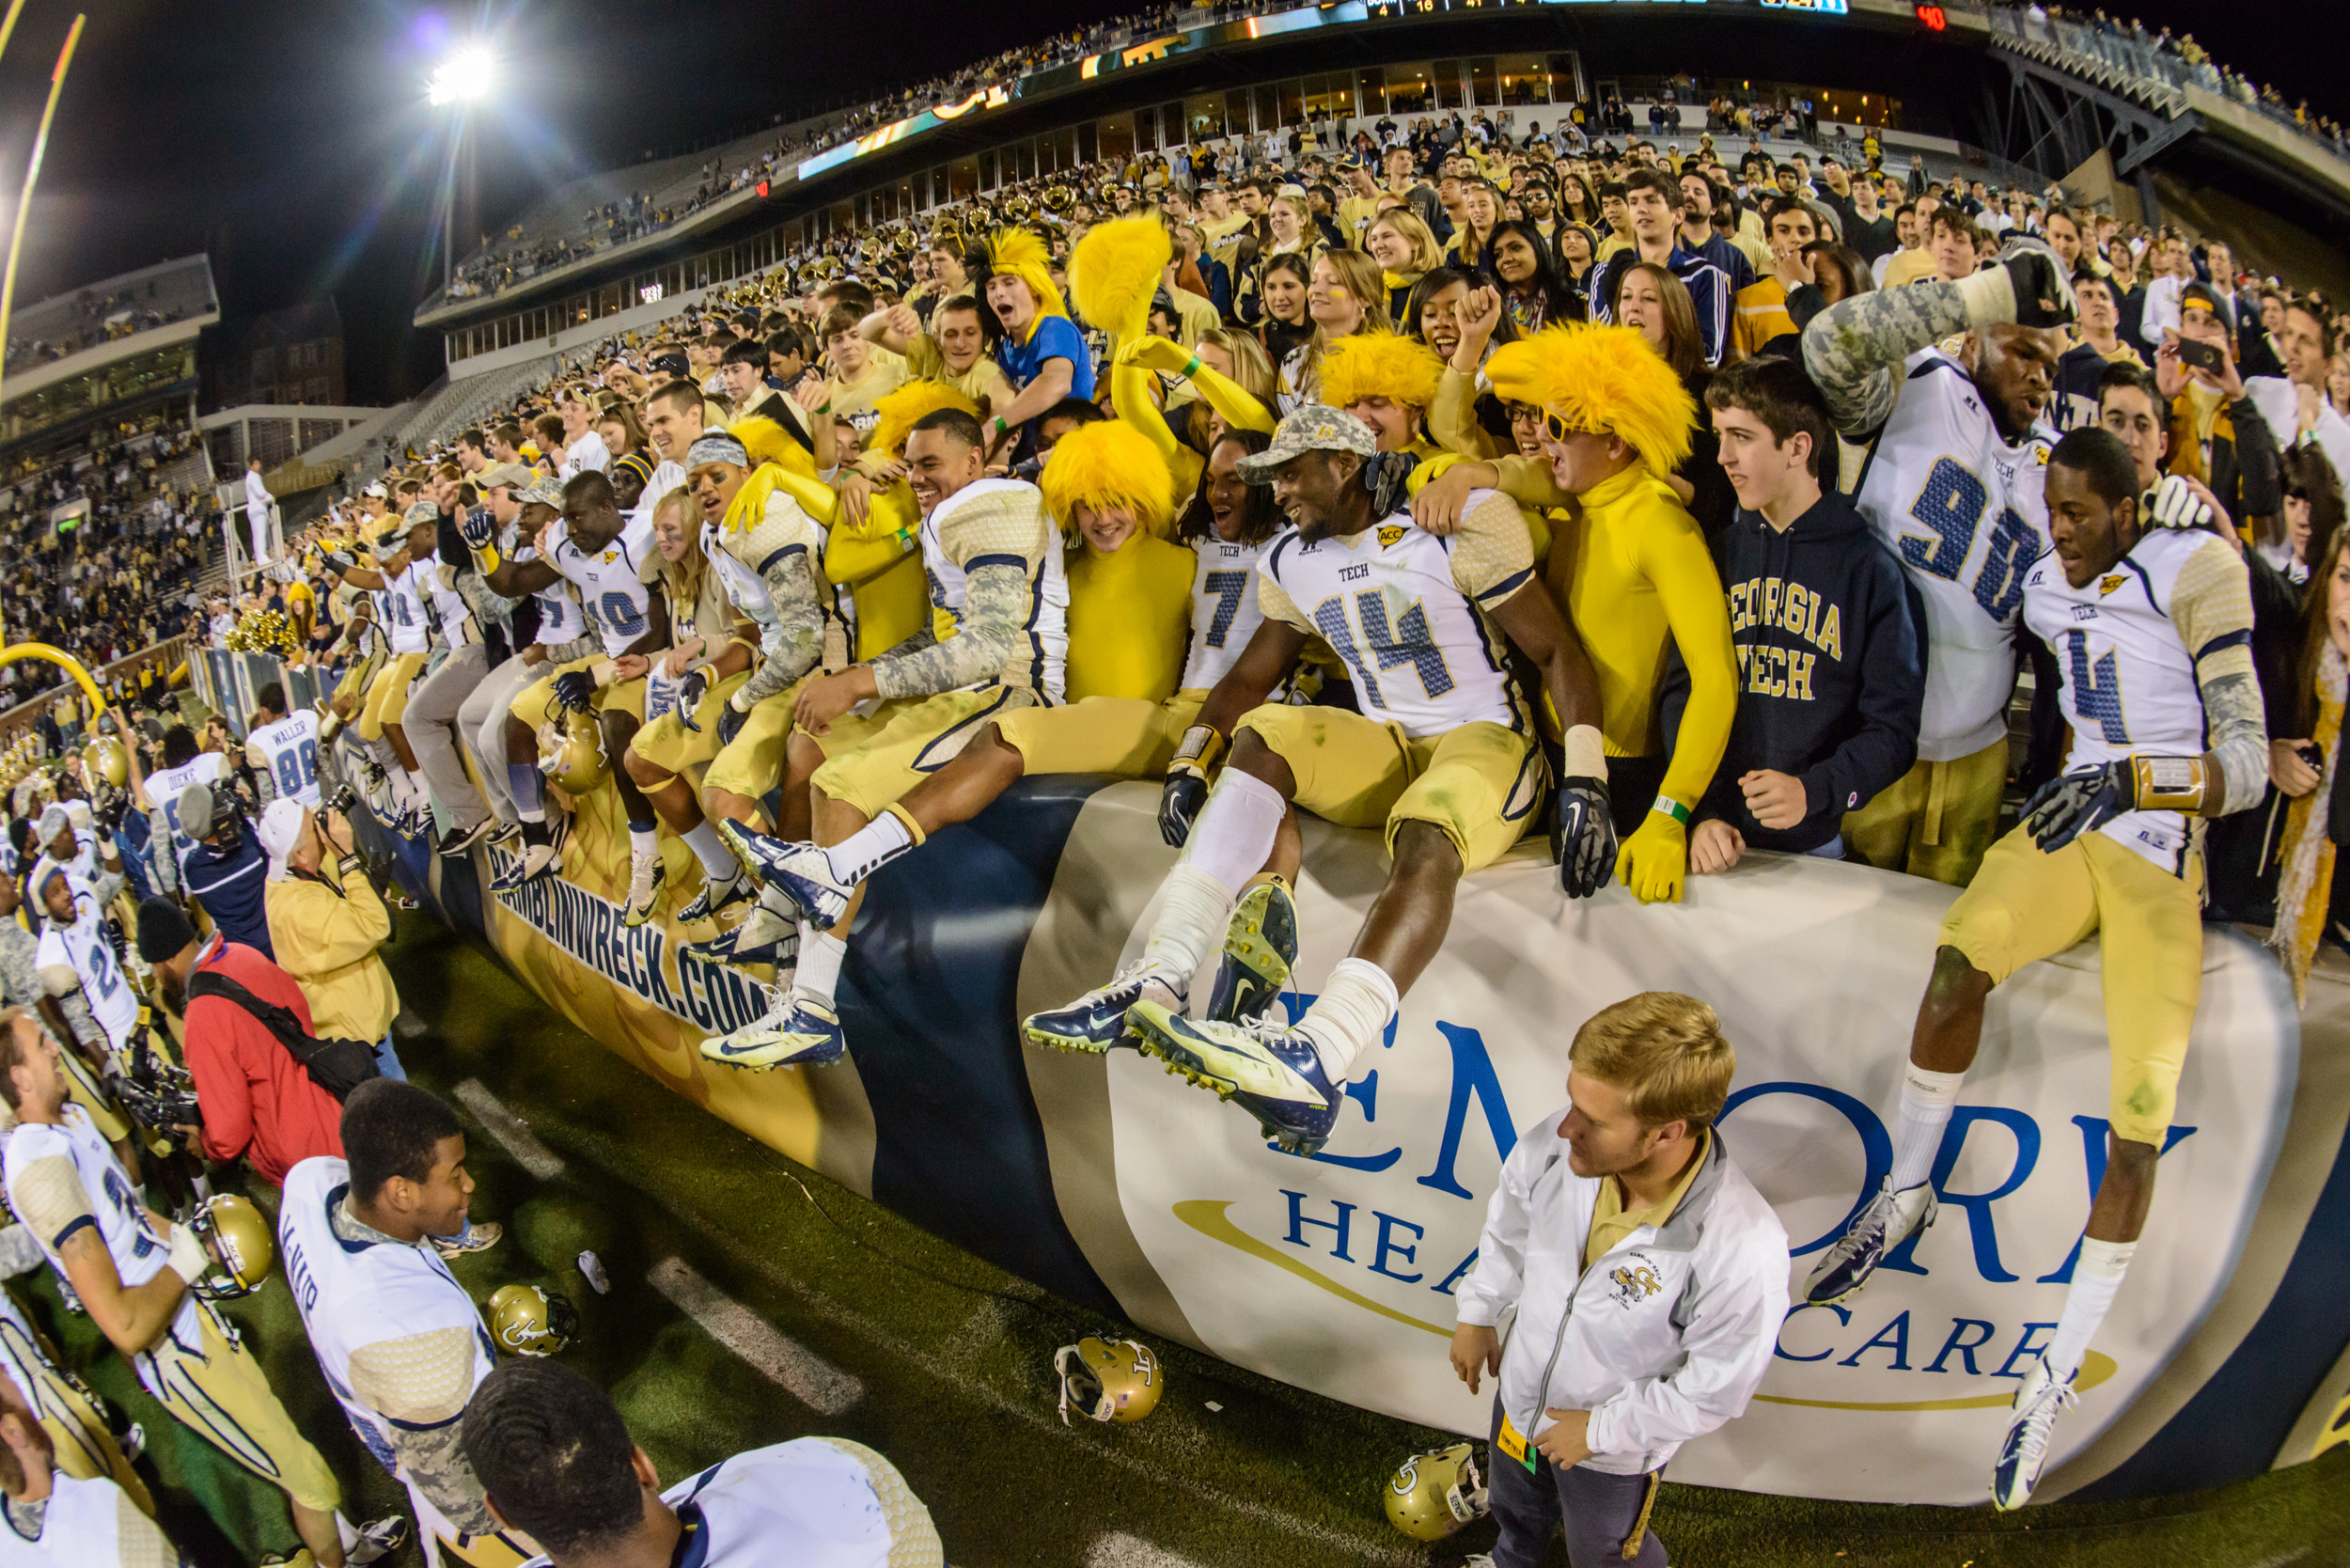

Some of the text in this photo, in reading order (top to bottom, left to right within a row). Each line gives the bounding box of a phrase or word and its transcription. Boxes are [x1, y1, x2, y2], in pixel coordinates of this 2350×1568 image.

[1379, 4, 1388, 16] 4
[1416, 0, 1434, 12] 16
[1918, 6, 1945, 31] 40
[1212, 233, 1246, 249] SWAR
[1219, 545, 1239, 557] TECH
[1380, 531, 1402, 541] ACC
[1339, 564, 1369, 582] TECH
[586, 591, 646, 636] 10
[1203, 569, 1249, 650] 7
[1725, 576, 1842, 663] EORGIA
[2070, 603, 2097, 621] TECH
[1312, 587, 1457, 712] 14
[1735, 644, 1816, 701] TECH
[2067, 628, 2133, 748] 4
[271, 721, 307, 747] WALLER
[275, 738, 319, 796] 88
[1775, 1303, 2059, 1380] CARE
